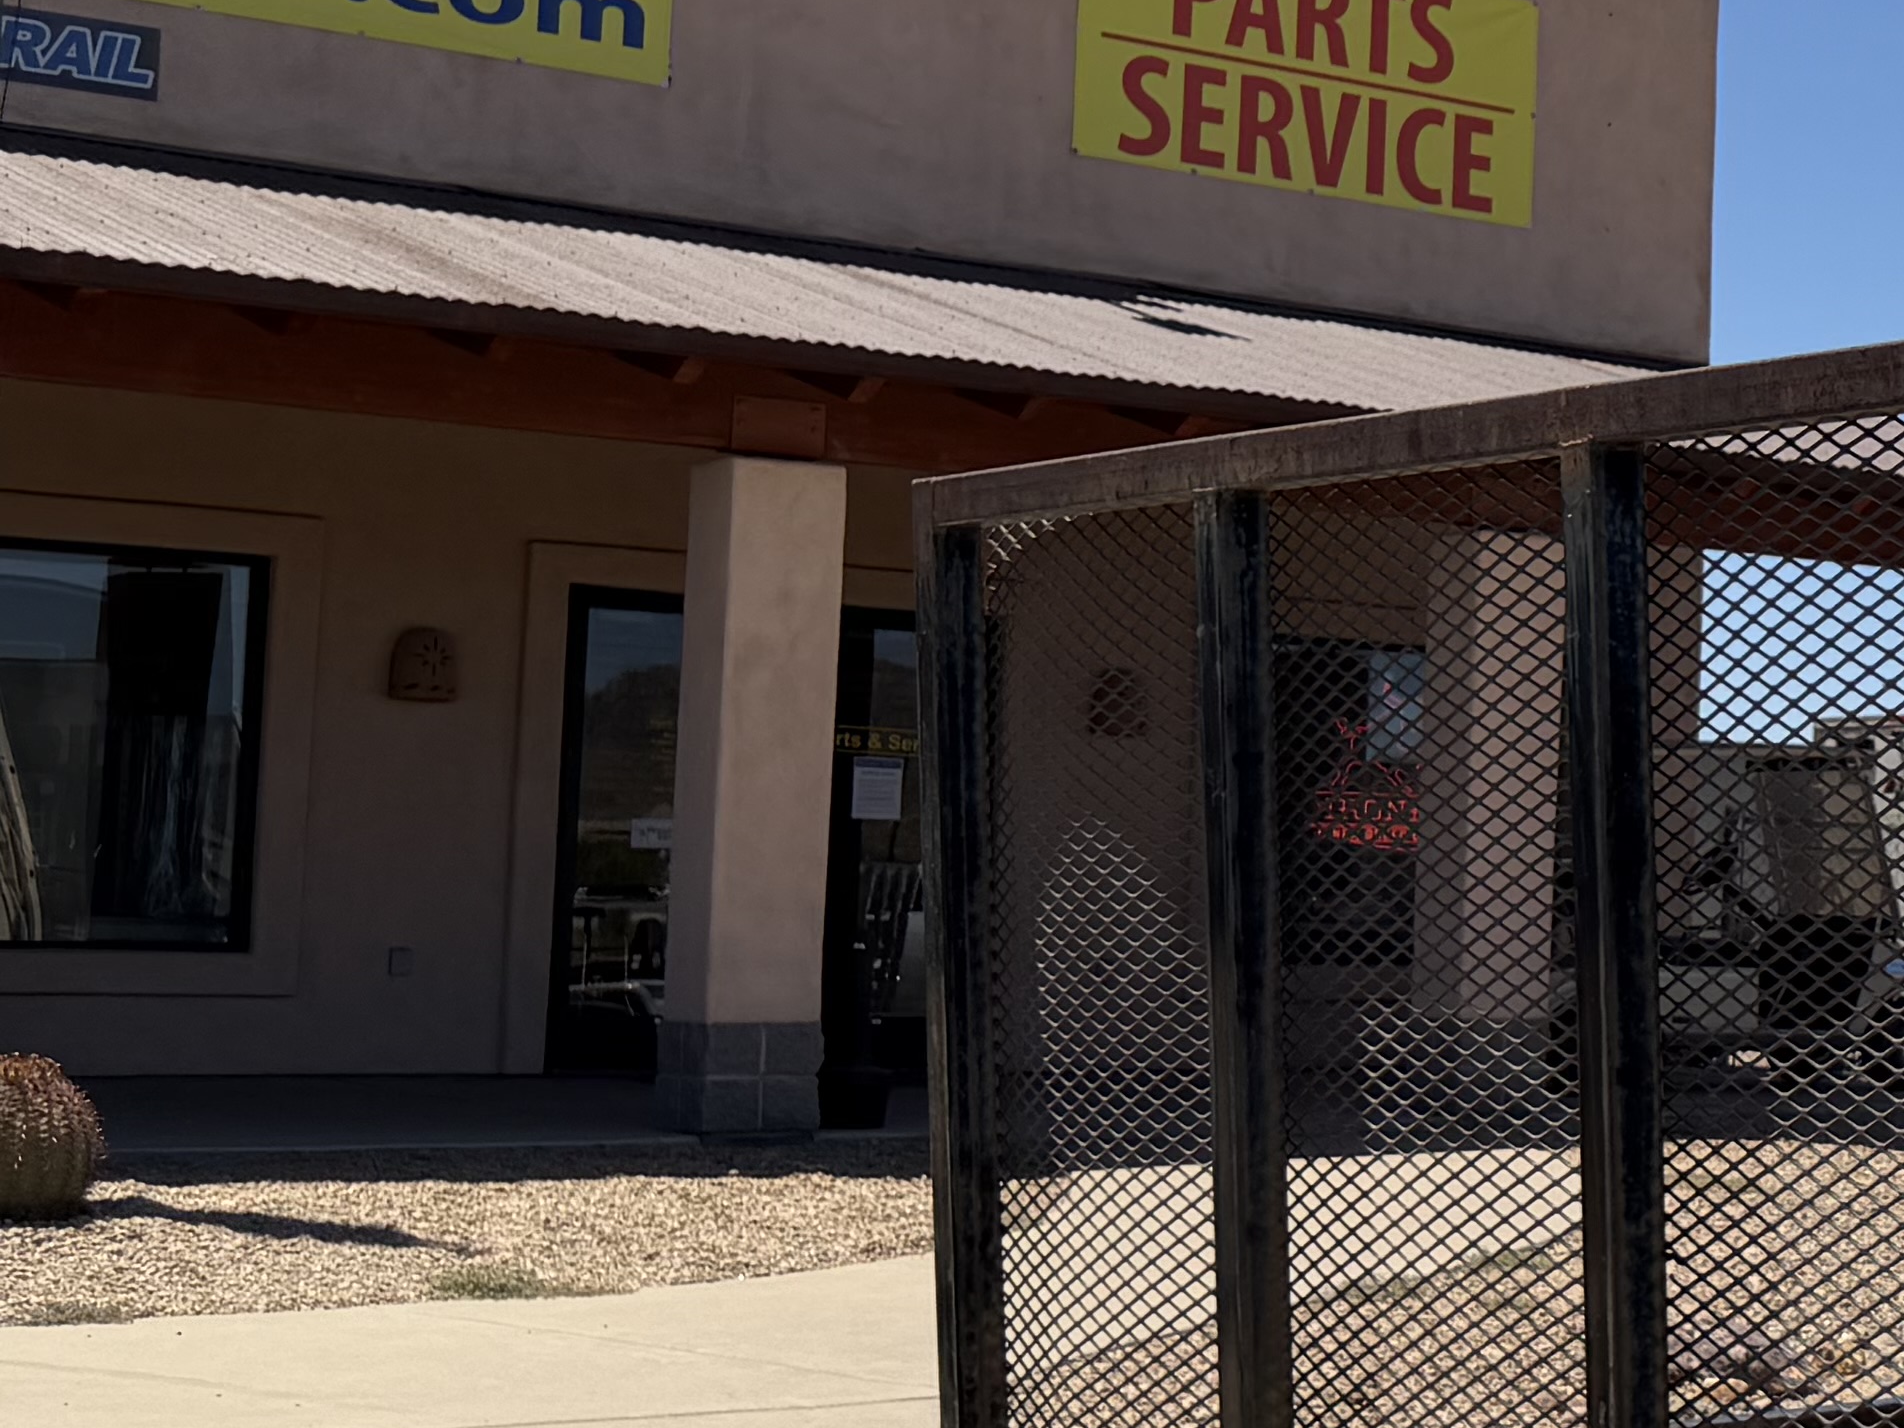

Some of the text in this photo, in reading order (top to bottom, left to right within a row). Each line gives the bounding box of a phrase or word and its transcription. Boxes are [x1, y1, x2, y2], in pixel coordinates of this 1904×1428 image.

[0, 15, 155, 89] RAIL
[1117, 54, 1494, 214] SERVICE
[867, 732, 882, 749] &
